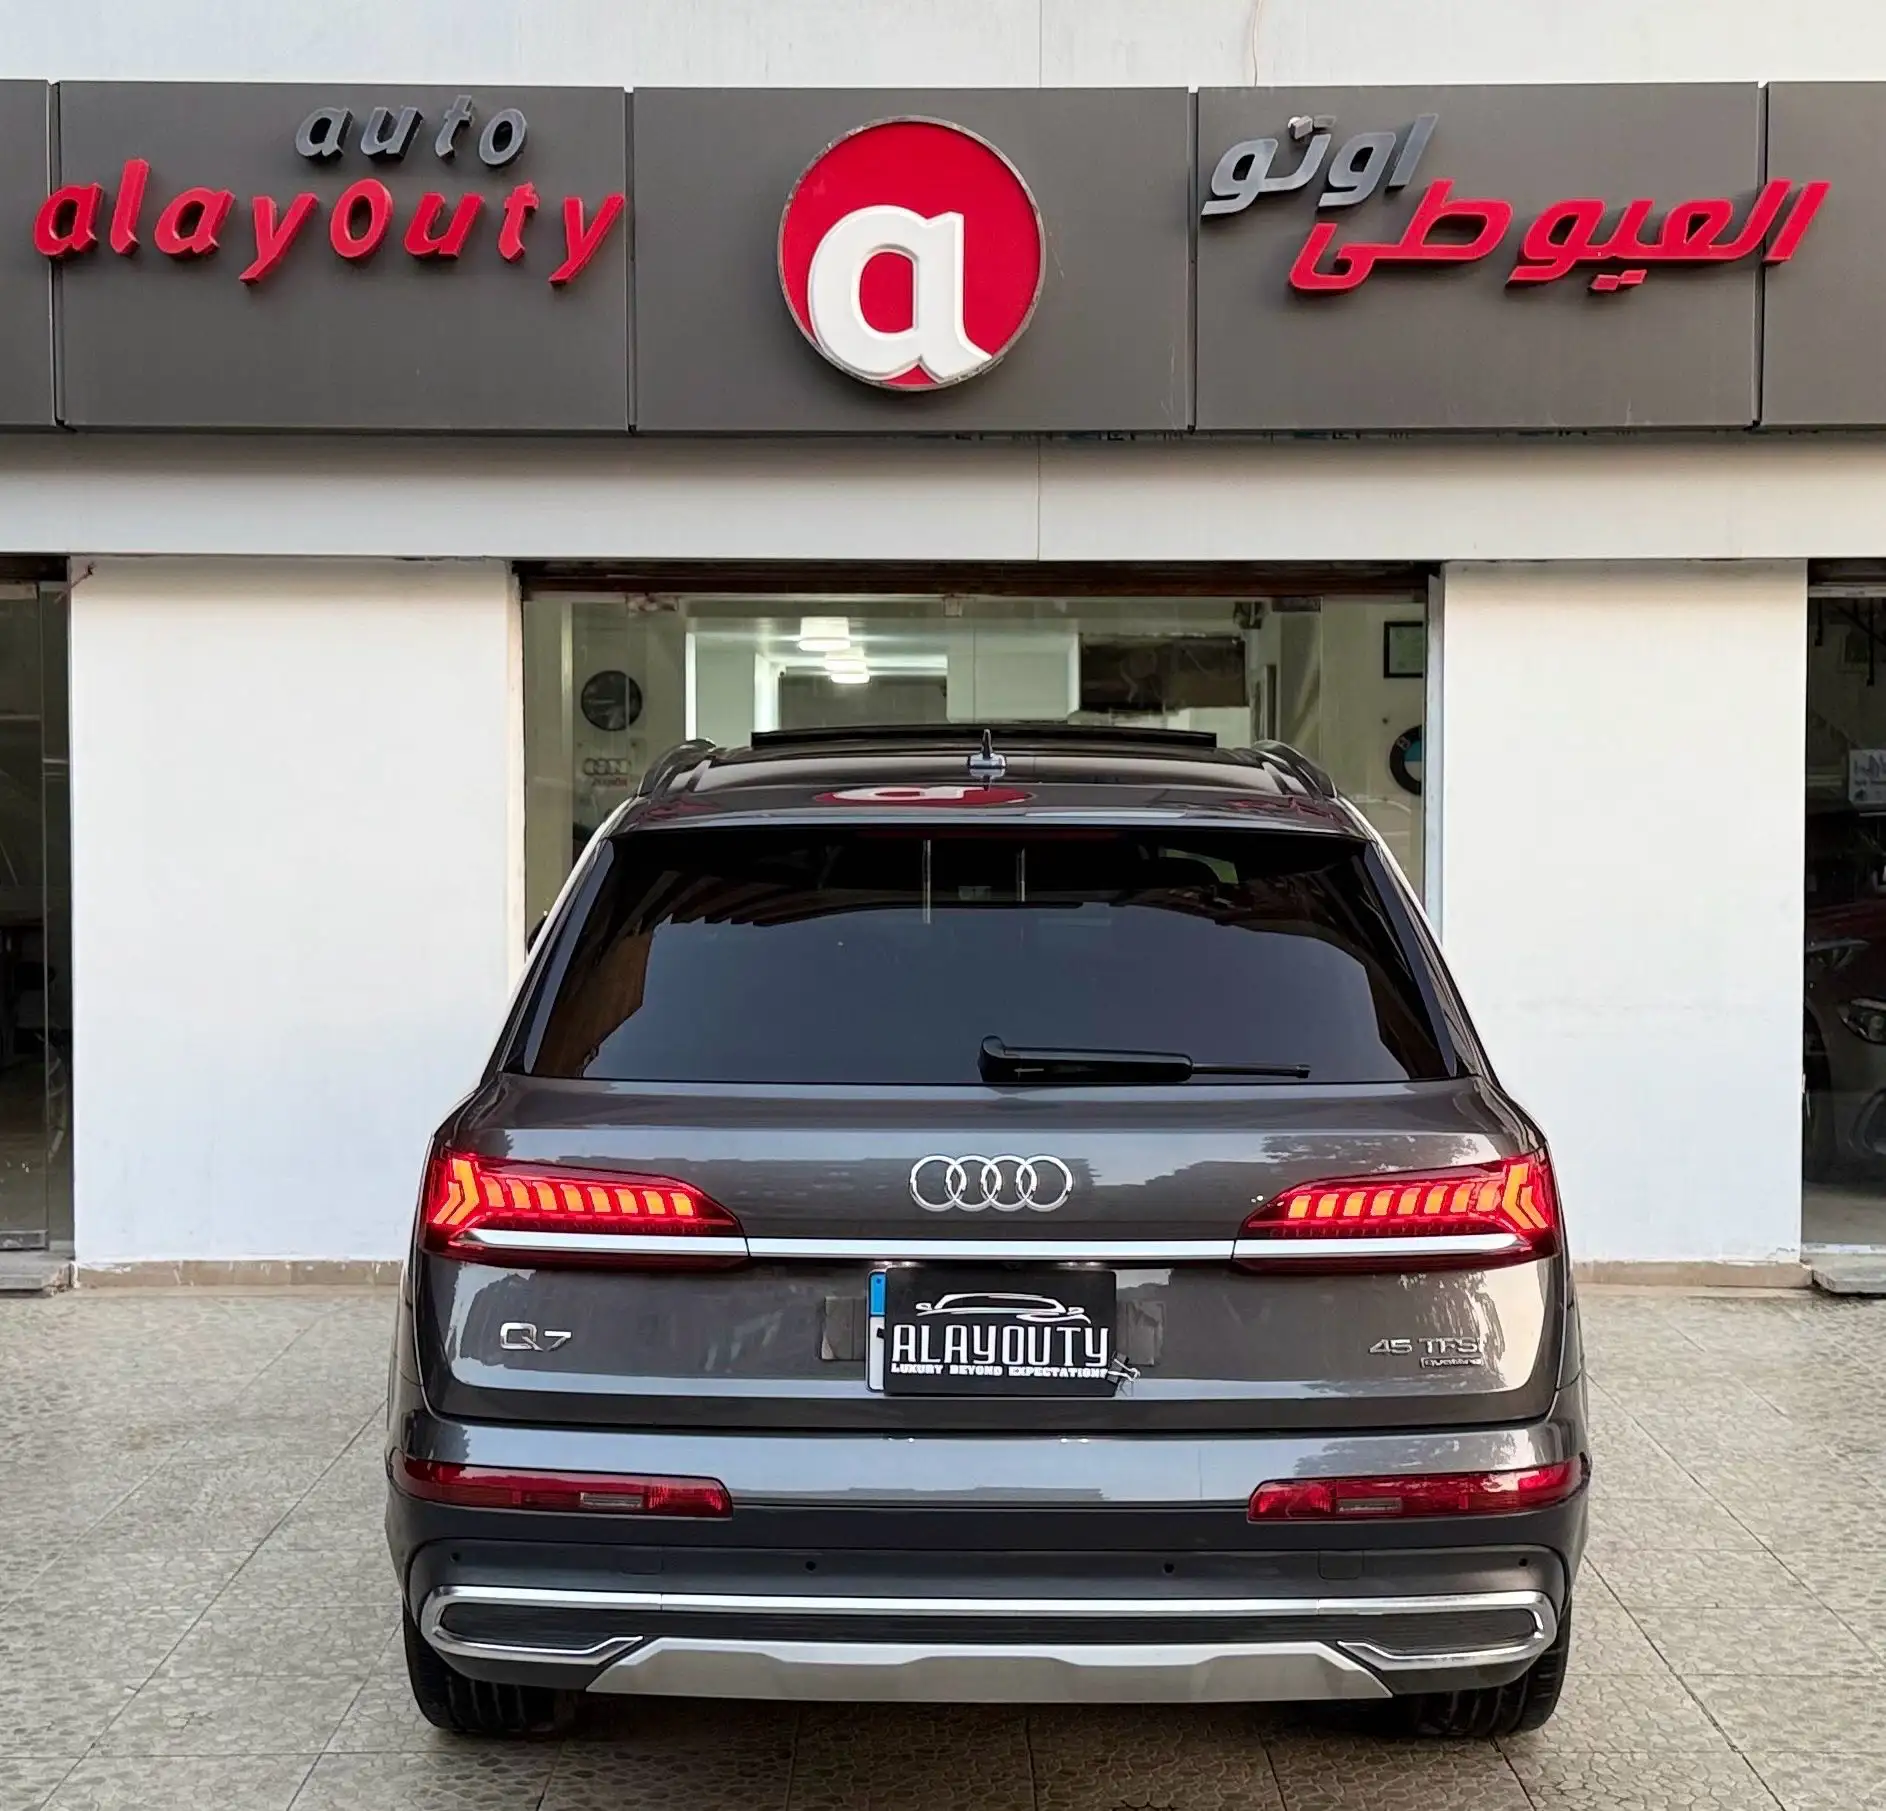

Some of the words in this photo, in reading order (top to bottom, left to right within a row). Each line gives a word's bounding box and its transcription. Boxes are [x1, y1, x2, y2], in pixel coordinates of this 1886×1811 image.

[295, 94, 528, 167] auto
[807, 204, 993, 384] a
[500, 1322, 572, 1352] Q7
[891, 1324, 1109, 1367] ALAYOUTY
[1368, 1338, 1413, 1354] 45
[1418, 1336, 1486, 1354] TFSI
[890, 1362, 943, 1375] LUXURY
[949, 1364, 1003, 1376] BEYOND
